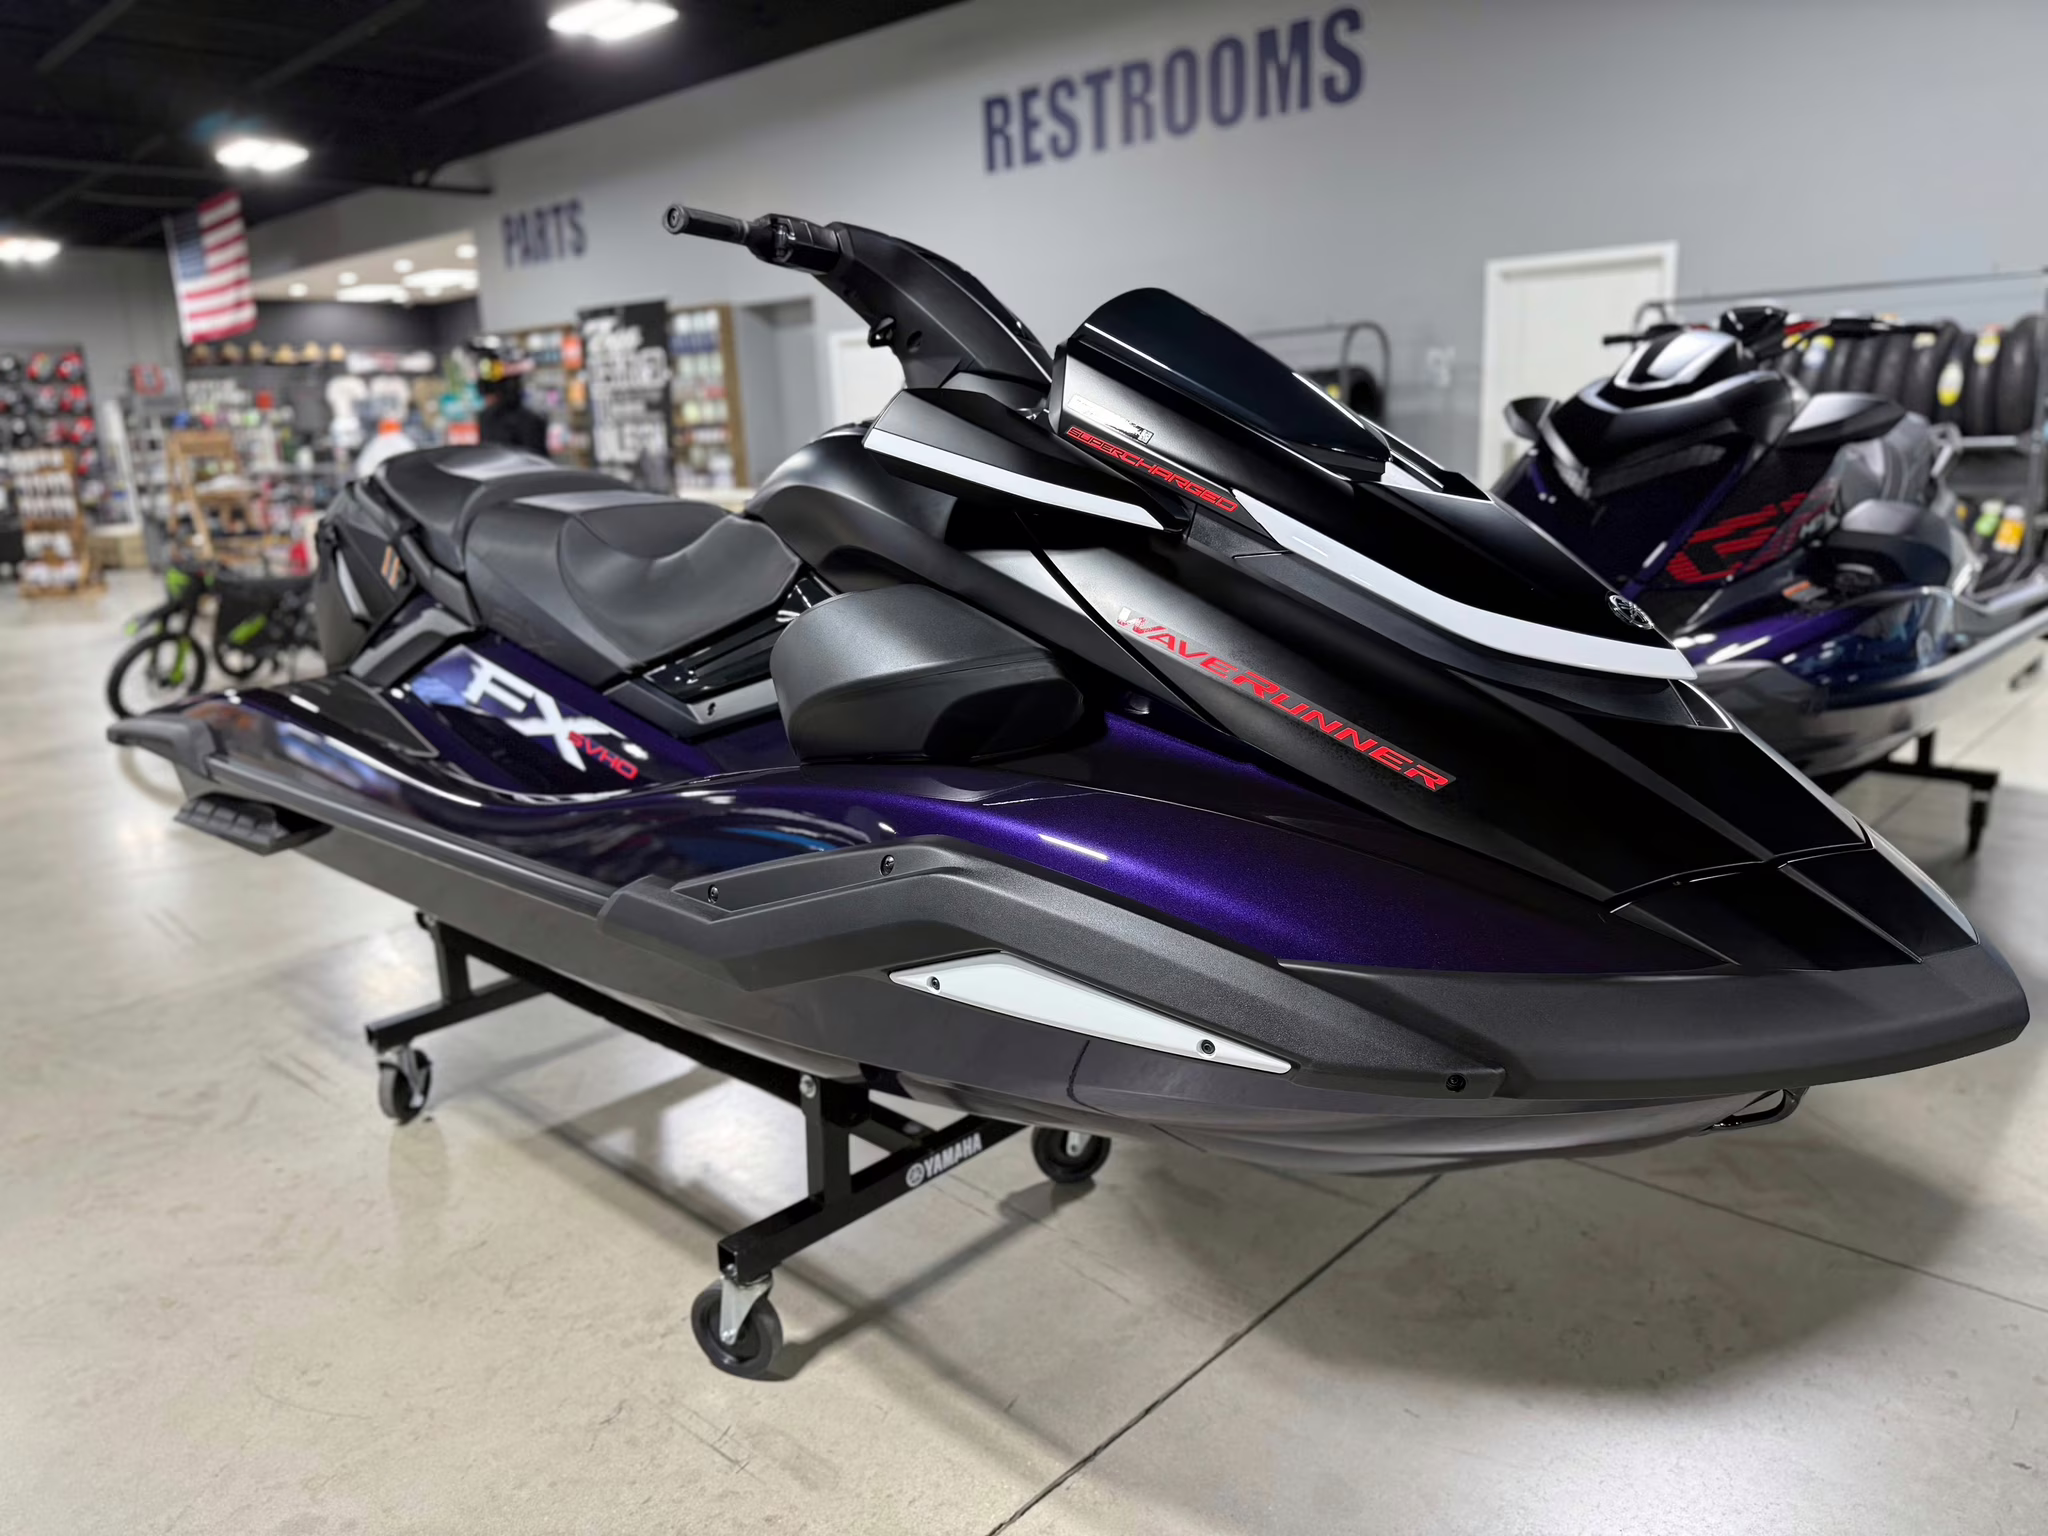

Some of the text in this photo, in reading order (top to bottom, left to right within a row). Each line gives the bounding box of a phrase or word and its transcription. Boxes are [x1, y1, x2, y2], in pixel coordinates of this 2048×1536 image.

[982, 6, 1366, 173] RESTROOMS
[502, 199, 588, 268] PARTS
[1067, 426, 1239, 513] SUPERCHARGED
[1115, 607, 1452, 791] WAVERUNNER
[567, 731, 640, 781] SVHO
[923, 1132, 983, 1179] YAMAHA
